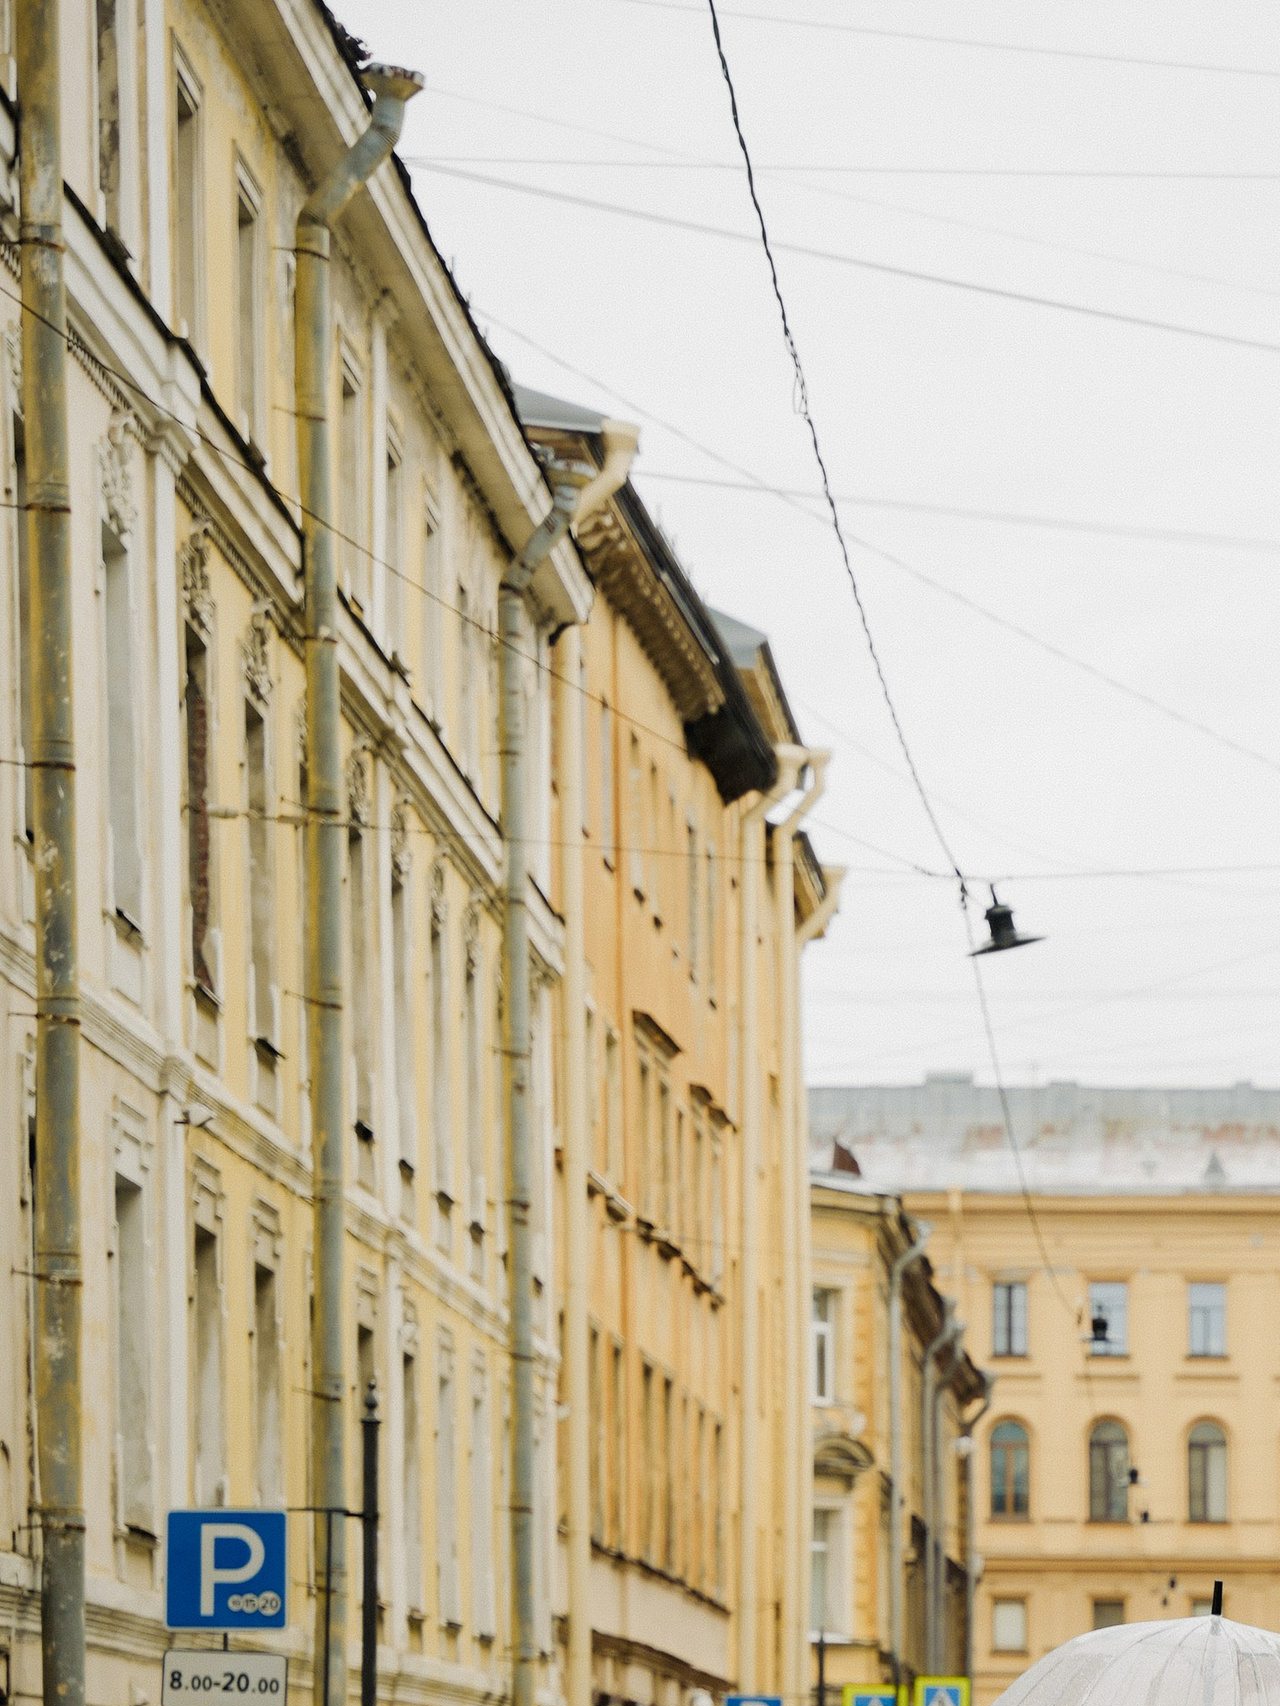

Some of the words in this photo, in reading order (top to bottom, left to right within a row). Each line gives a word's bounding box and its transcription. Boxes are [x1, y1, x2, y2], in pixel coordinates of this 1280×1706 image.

[200, 1522, 265, 1617] P
[261, 1597, 279, 1610] 20
[169, 1670, 280, 1694] 8.00-20.00
